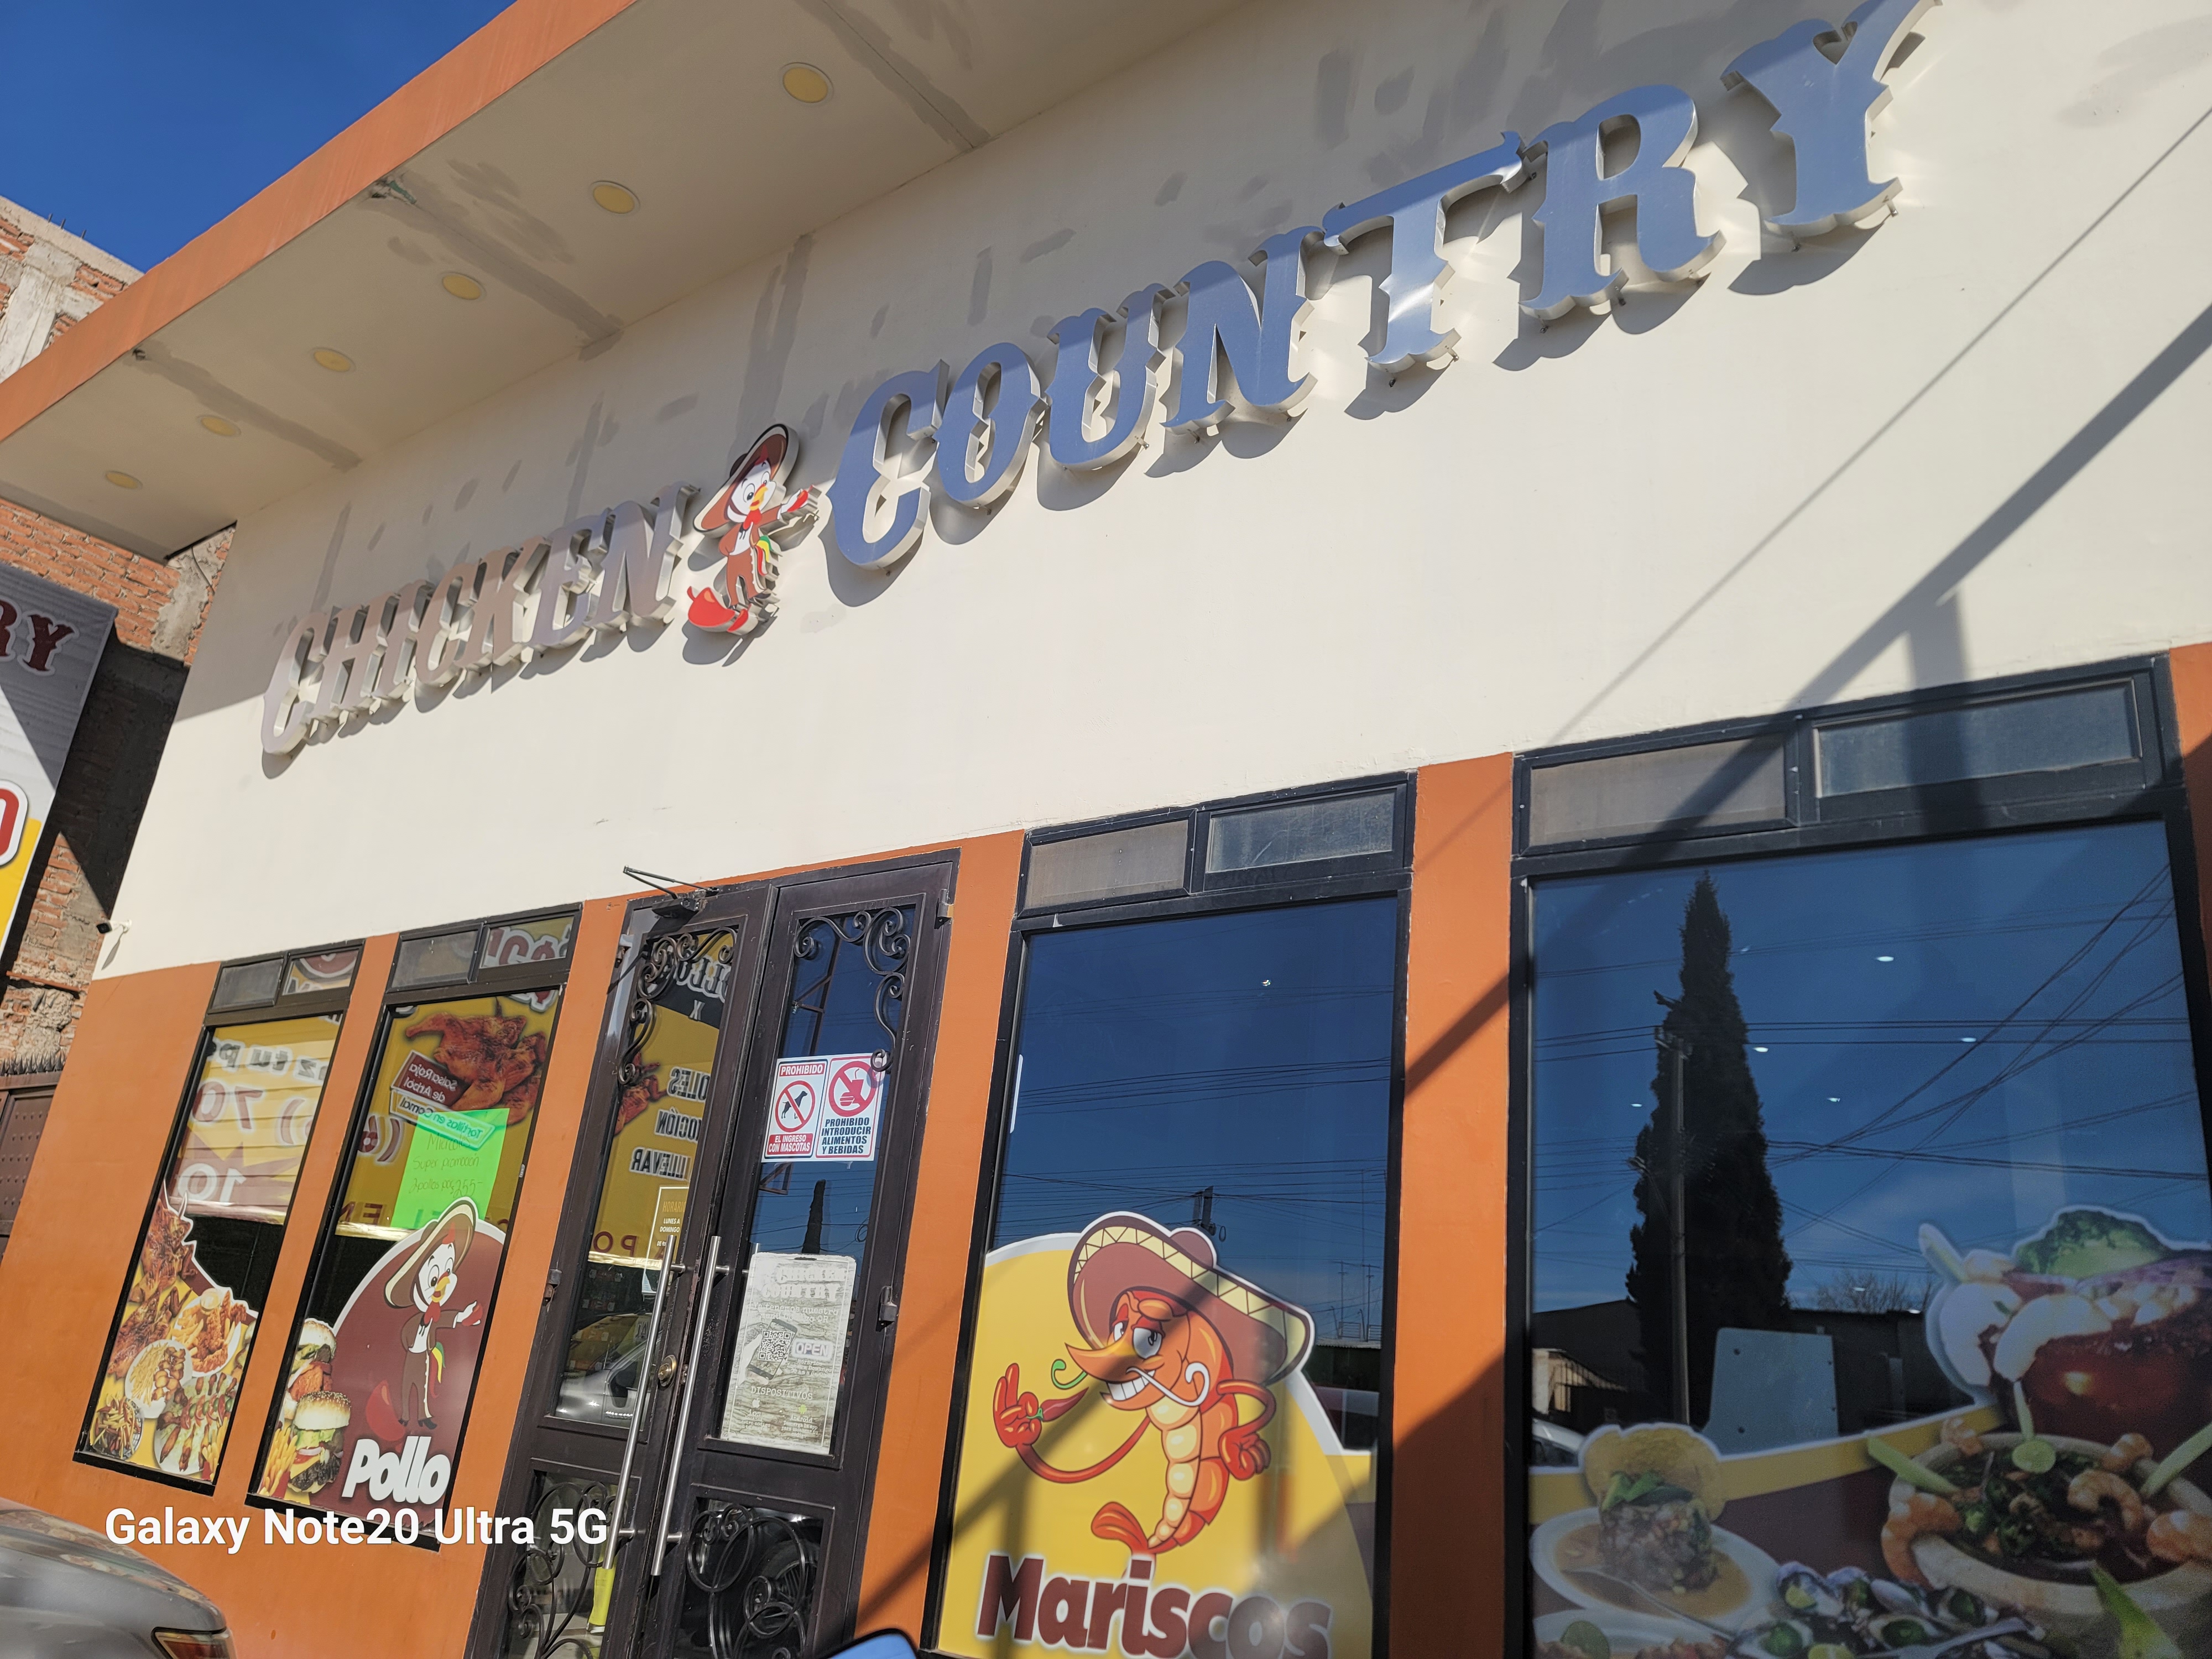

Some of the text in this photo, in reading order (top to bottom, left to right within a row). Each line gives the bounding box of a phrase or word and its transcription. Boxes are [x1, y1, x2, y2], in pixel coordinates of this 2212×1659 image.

[262, 0, 1939, 755] CHICKEN COUNTRY
[781, 1064, 823, 1076] PROHIBIDO
[825, 1117, 870, 1128] PROHIBIDO
[821, 1126, 872, 1136] INTRODUCIR
[782, 1134, 807, 1143] INGRESO
[822, 1135, 868, 1145] ALIMENTOS
[768, 1142, 811, 1152] CON MASCOTAS
[822, 1145, 864, 1155] Y BEBIDAS
[765, 1303, 800, 1312] tenemos
[795, 1342, 829, 1356] OPEN
[750, 1386, 813, 1400] DISPOSITIVOS
[790, 1415, 813, 1423] Android
[342, 1436, 451, 1505] Pollo
[977, 1554, 1333, 1659] Mariscos
